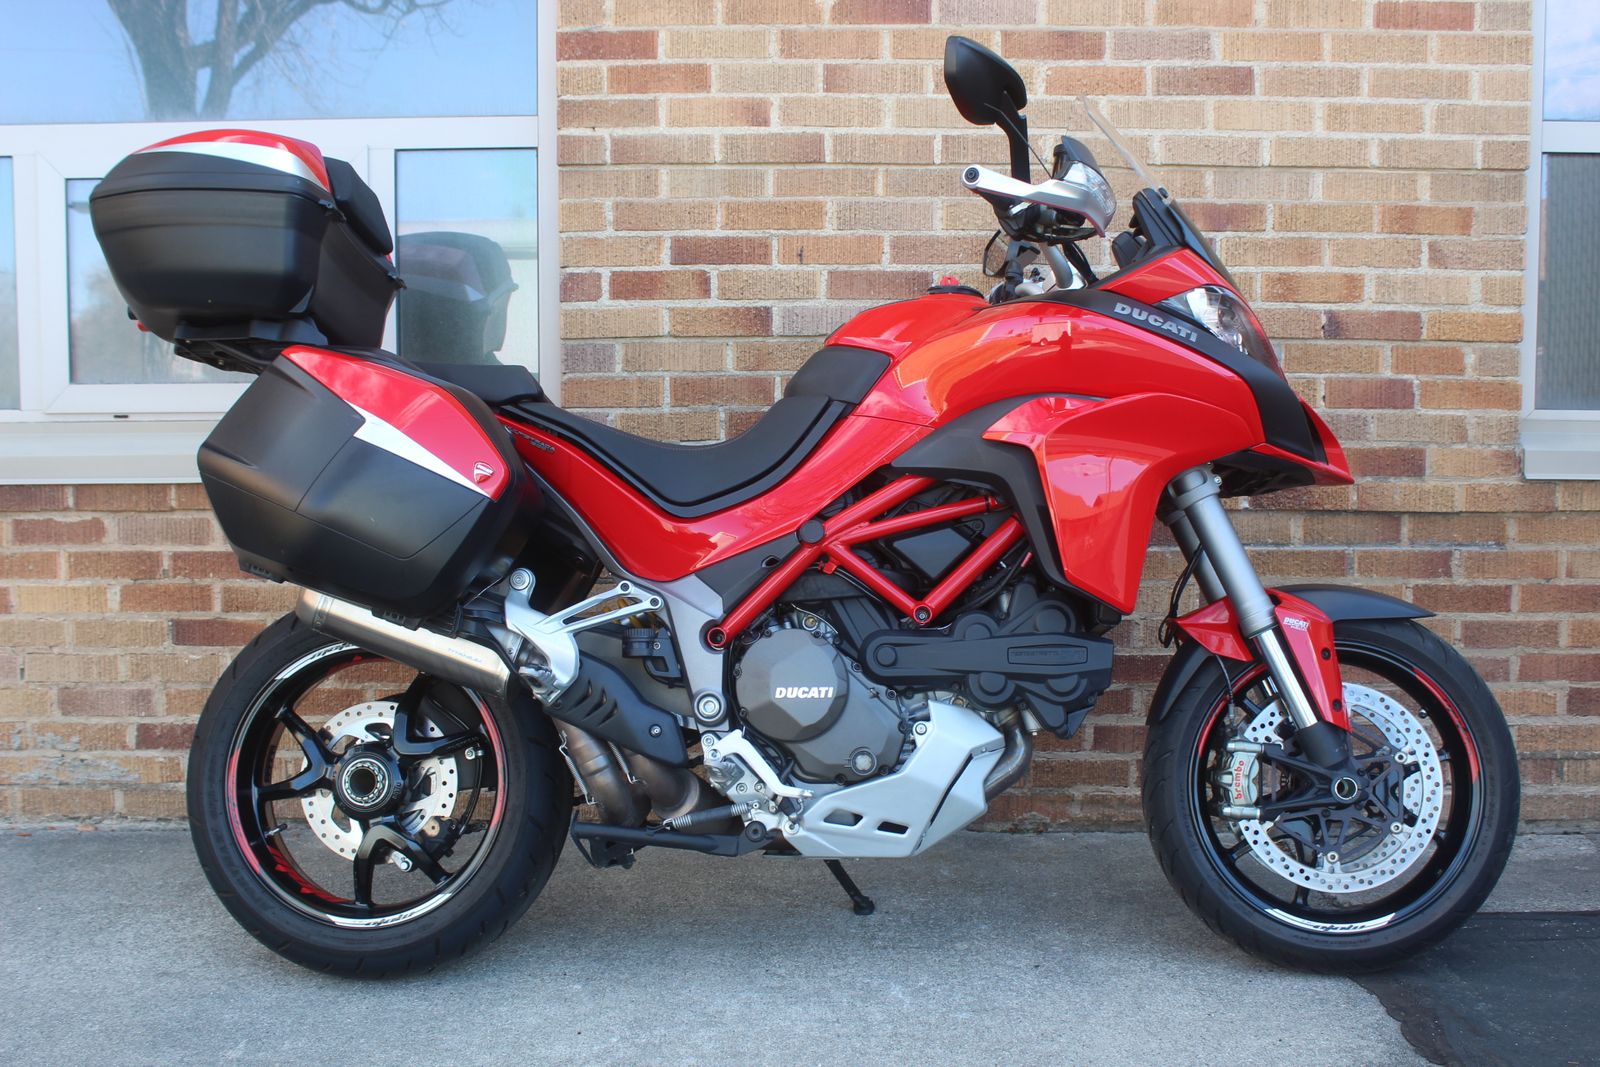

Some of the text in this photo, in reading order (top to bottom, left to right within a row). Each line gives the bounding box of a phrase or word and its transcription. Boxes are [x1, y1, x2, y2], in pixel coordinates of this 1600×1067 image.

[1113, 302, 1198, 343] DUCATI
[1284, 616, 1309, 628] DUCATI
[775, 686, 834, 699] DUCATI
[1234, 760, 1245, 800] brembo
